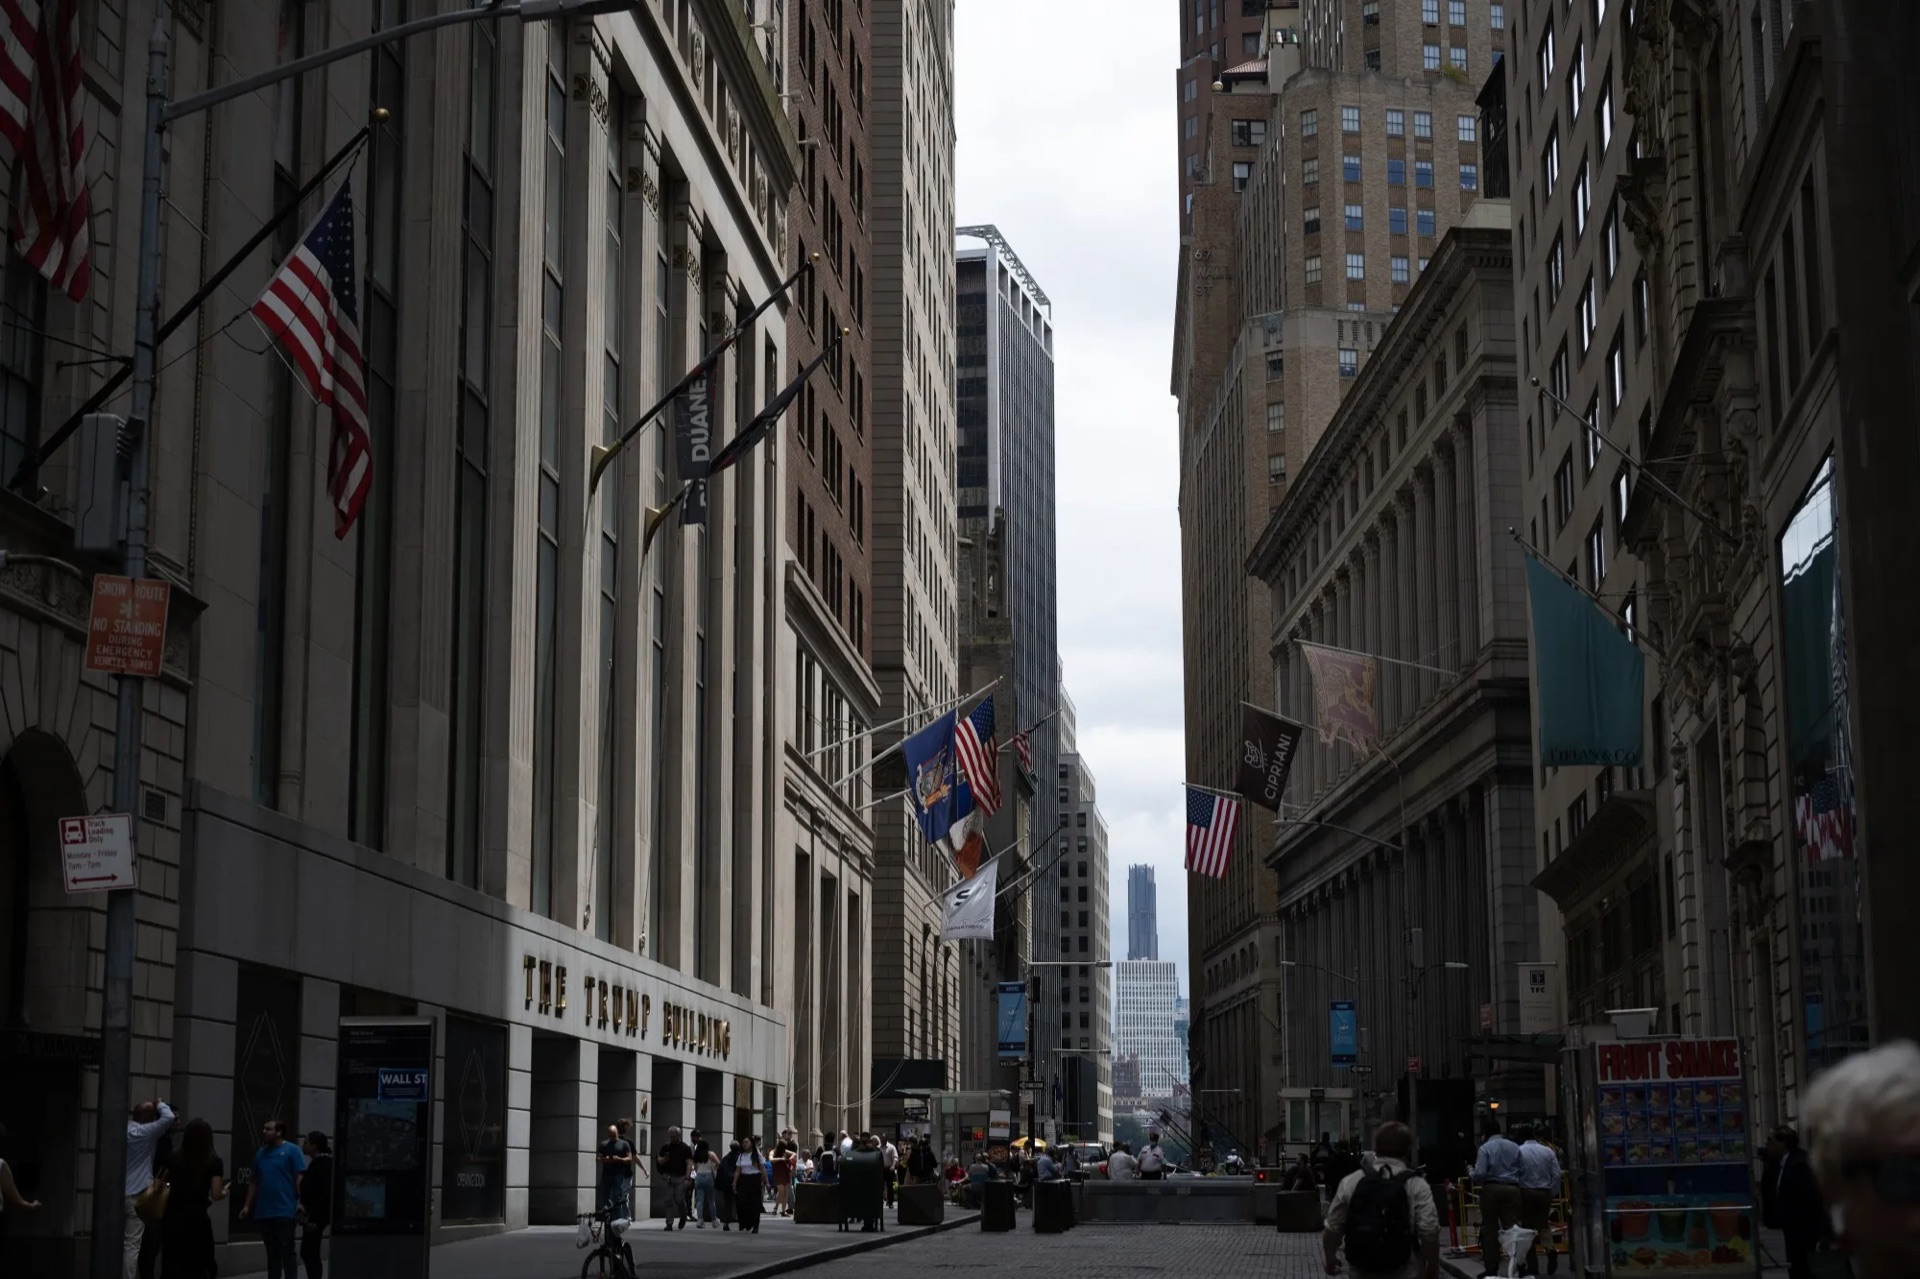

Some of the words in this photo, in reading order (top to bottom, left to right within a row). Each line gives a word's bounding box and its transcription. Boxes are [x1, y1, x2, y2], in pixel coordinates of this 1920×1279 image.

[1195, 249, 1211, 260] 67
[689, 379, 710, 463] DUANE
[97, 581, 128, 597] SNOW
[134, 583, 167, 601] ROUTE
[93, 617, 108, 632] NO
[113, 618, 161, 637] STANDING
[108, 634, 143, 646] DURING
[96, 644, 153, 659] EMERGENCY
[1264, 733, 1292, 800] CIPRIANI
[88, 827, 114, 835] Loading
[89, 836, 104, 844] Only
[67, 851, 92, 859] Monday
[1530, 986, 1545, 994] TFC
[523, 954, 567, 1012] THE
[584, 976, 651, 1033] TRUMP
[663, 1001, 731, 1057] BUILDING
[1598, 1042, 1662, 1081] FRUIT
[381, 1073, 412, 1085] WALL
[414, 1073, 428, 1084] ST
